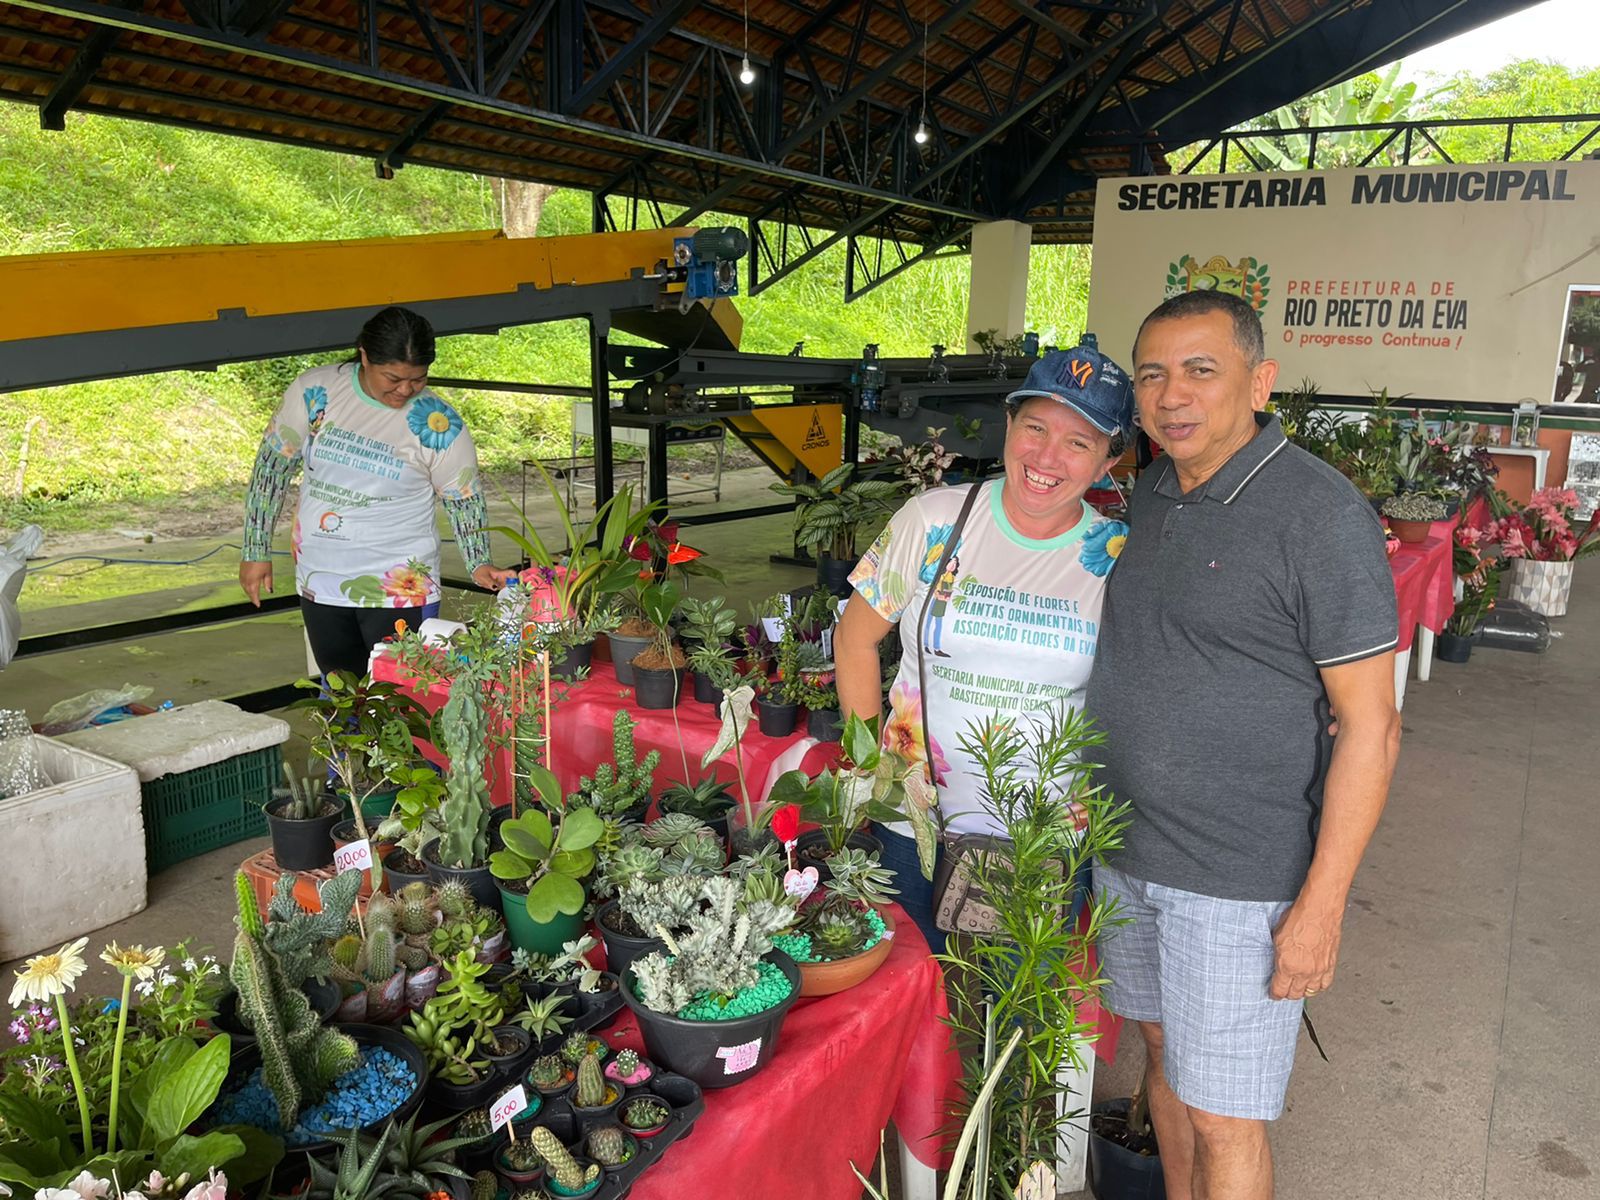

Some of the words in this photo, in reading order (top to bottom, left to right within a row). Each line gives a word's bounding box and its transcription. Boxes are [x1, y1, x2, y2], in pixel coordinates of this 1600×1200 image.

[1118, 177, 1326, 211] SECRETARIA
[1351, 169, 1576, 204] MUNICIPAL
[1287, 280, 1416, 296] PREFEITURA
[1431, 281, 1455, 296] DE
[1284, 298, 1317, 327] RIO
[1324, 298, 1392, 328] PRETO
[1398, 299, 1424, 329] DA
[1432, 299, 1467, 330] EVA
[1283, 329, 1294, 343] O
[1300, 332, 1373, 348] progresso
[1382, 332, 1451, 347] Continua
[802, 439, 830, 451] CRONOS
[964, 582, 1016, 603] EXPOSIÇÃO
[1018, 592, 1031, 606] DE
[1034, 595, 1070, 612] FLORES
[1073, 600, 1079, 614] E
[958, 600, 1005, 619] PLANTAS
[1008, 608, 1083, 634] ORNAMENTAIS
[952, 619, 1018, 643] ASSOCIAÇÃO
[1020, 629, 1060, 649] FLORES
[1063, 636, 1076, 652] DA
[932, 664, 974, 687] SECRETARIA
[976, 674, 1025, 694] MUNICIPAL
[1027, 682, 1037, 695] DE
[949, 686, 1018, 710] ABASTECIMENTO
[336, 848, 367, 870] 20,00
[495, 1100, 517, 1123] 5,00
